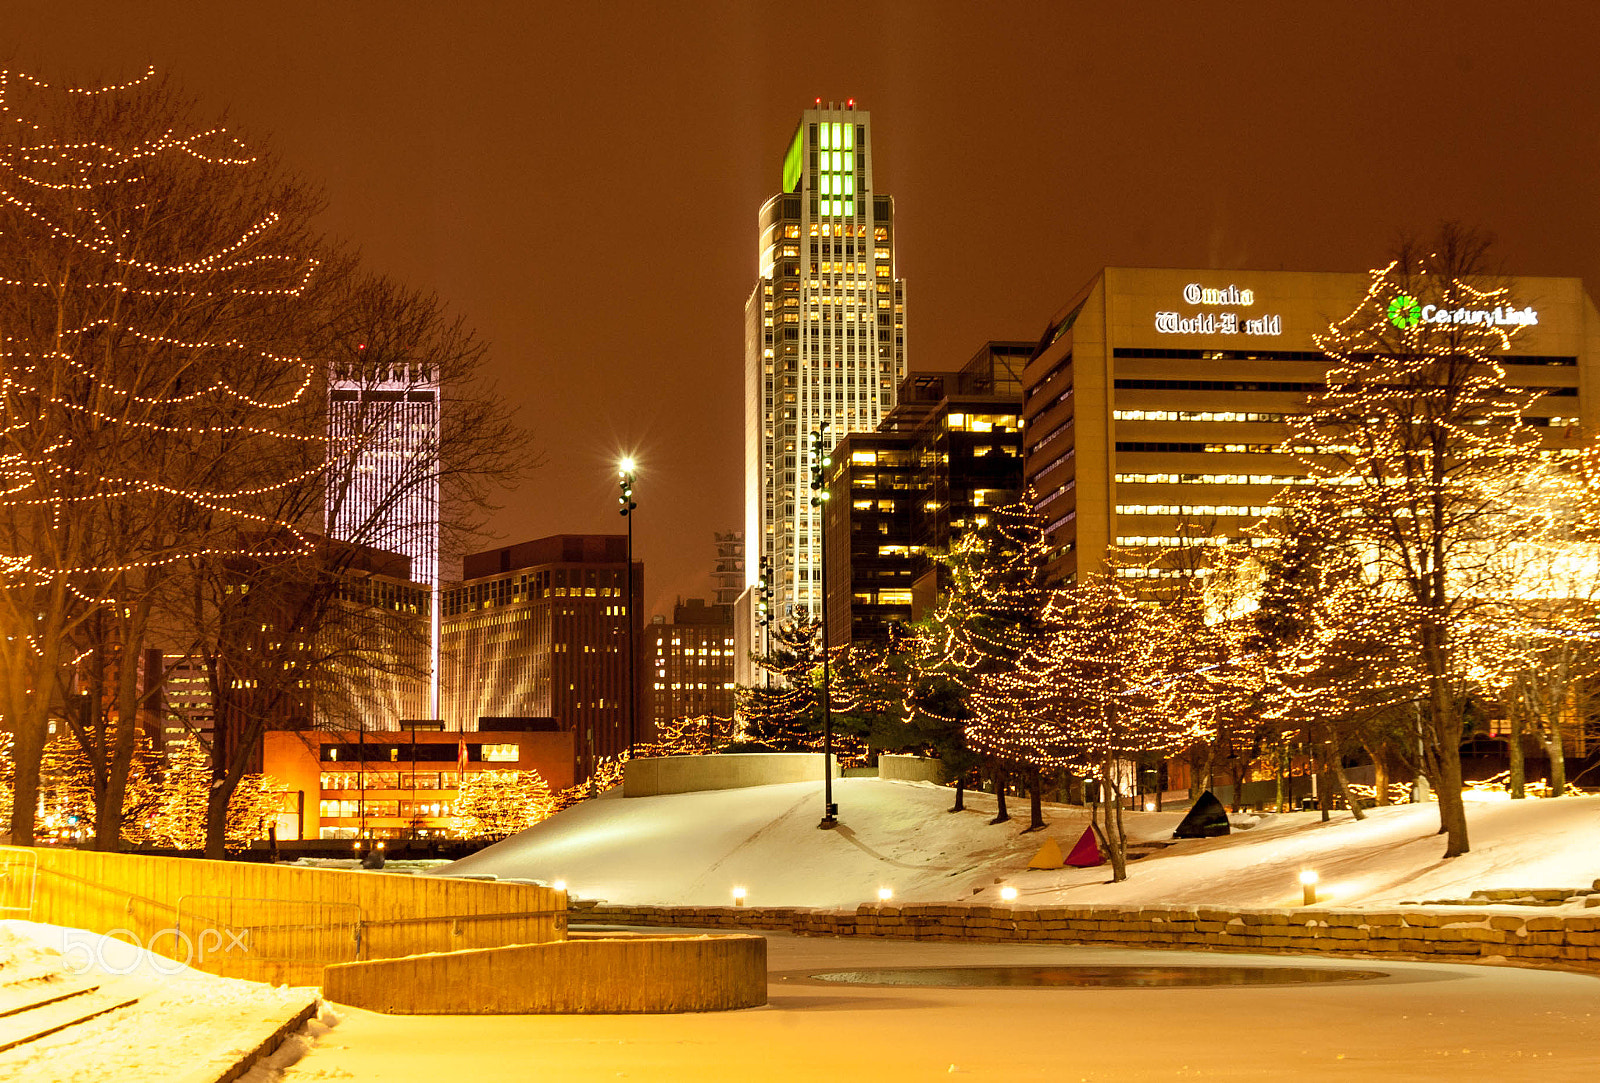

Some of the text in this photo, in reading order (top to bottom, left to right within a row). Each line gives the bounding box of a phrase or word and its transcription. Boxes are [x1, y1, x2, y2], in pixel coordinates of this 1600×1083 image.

[1183, 283, 1254, 306] Omaha
[1155, 311, 1282, 335] World-Herald
[1421, 304, 1539, 328] CenturyLink
